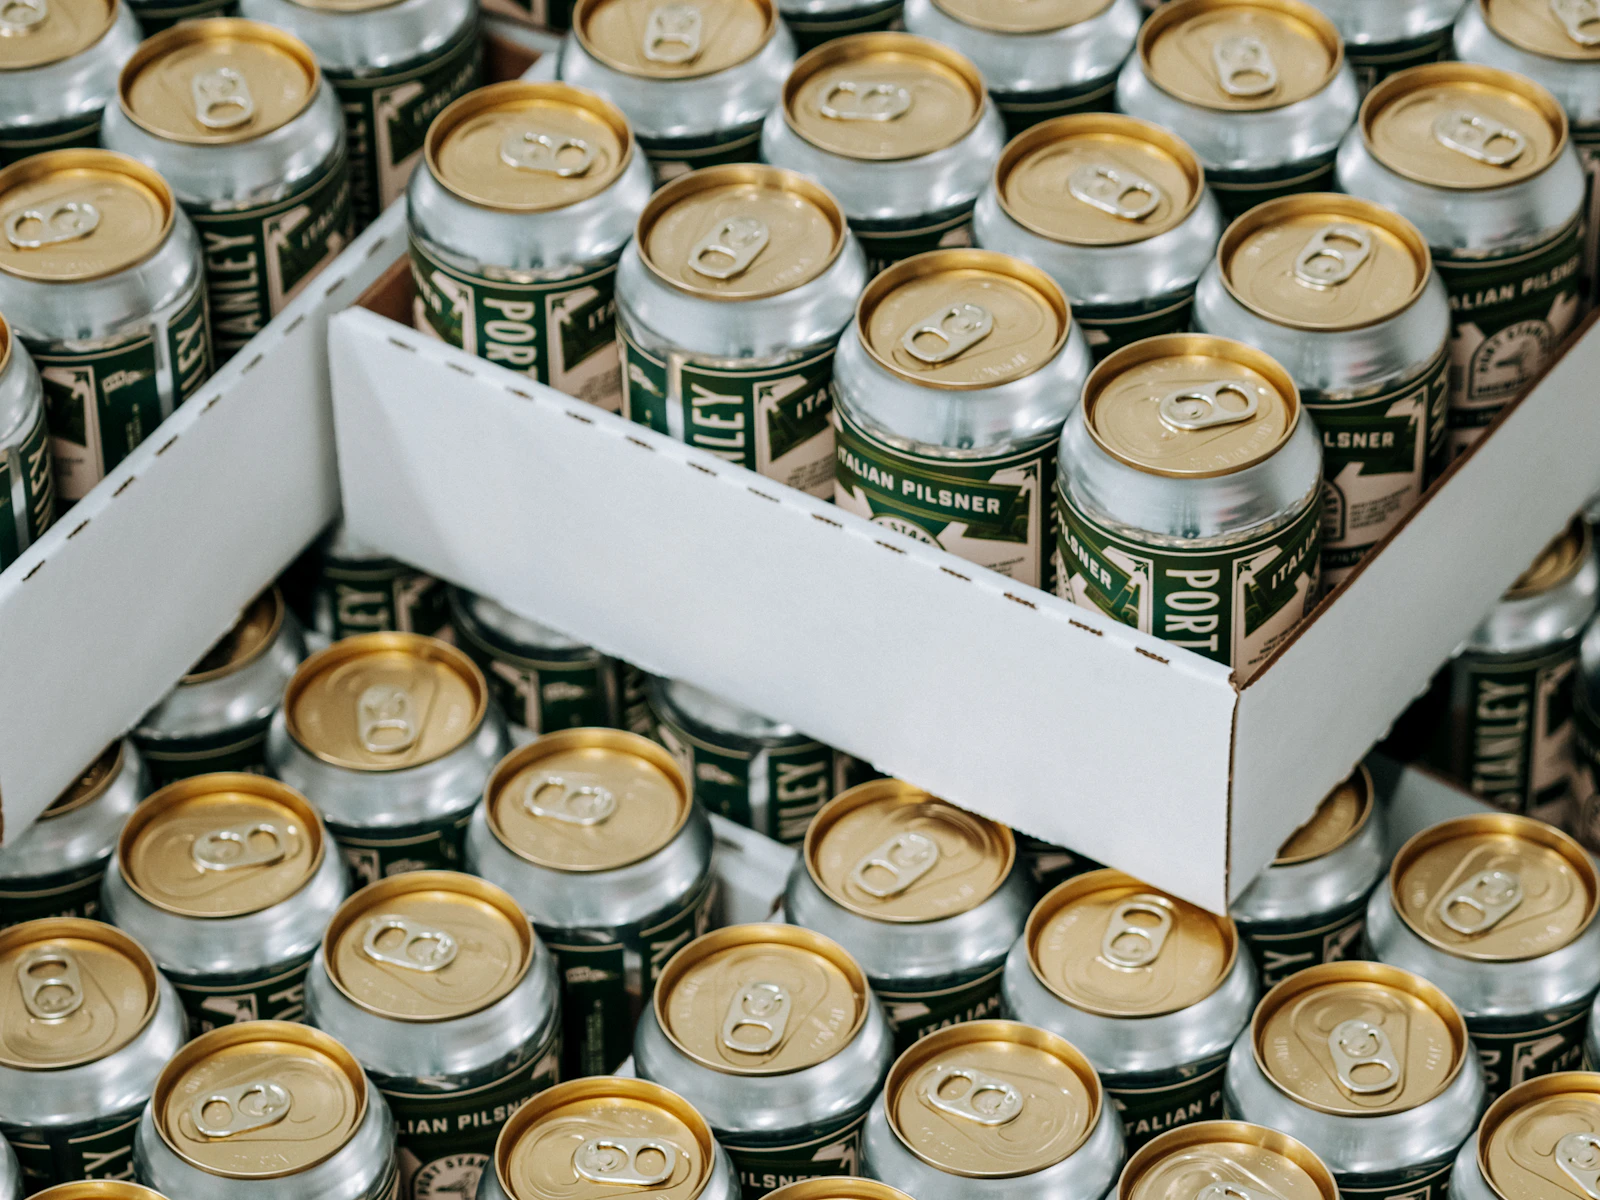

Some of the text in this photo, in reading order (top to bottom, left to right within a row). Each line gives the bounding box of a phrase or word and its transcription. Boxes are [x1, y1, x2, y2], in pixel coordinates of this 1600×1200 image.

[837, 445, 895, 491] ITALIAN
[902, 478, 1001, 516] PILSNER
[1165, 567, 1220, 653] PORT
